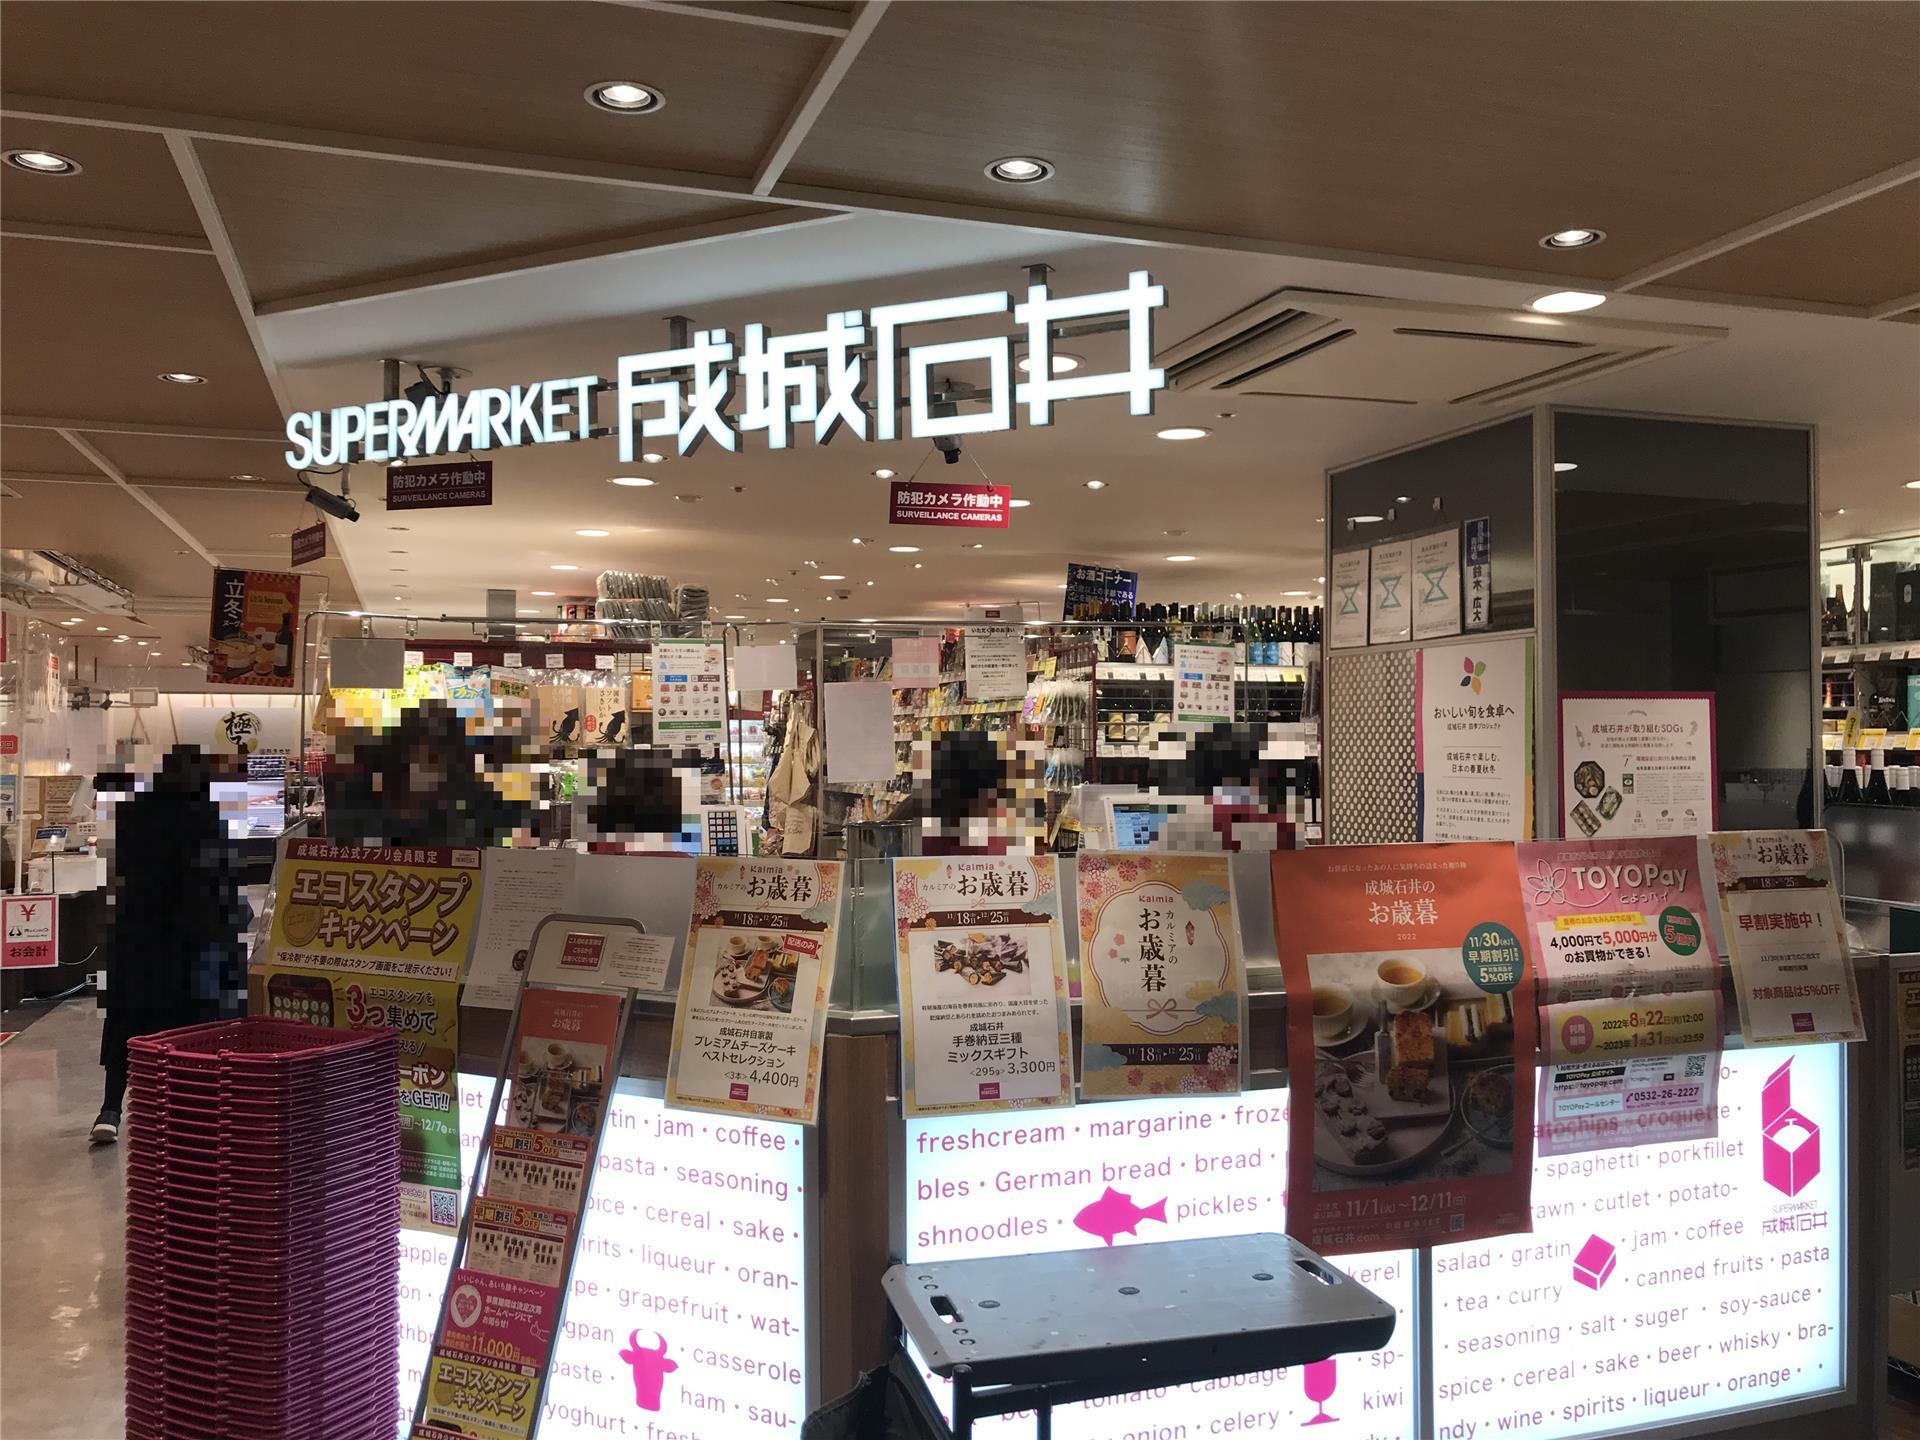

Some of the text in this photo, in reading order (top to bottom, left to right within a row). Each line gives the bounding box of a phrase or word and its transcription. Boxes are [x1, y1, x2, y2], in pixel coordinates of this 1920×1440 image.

[617, 270, 1167, 463] 成城石井
[285, 374, 598, 470] SUPERMARKET
[392, 470, 486, 489] 防犯カメラ作動中
[392, 490, 486, 503] SURVEILLANCE CAMERAS
[897, 490, 1003, 509] 防犯カメラ作動中
[896, 510, 1003, 522] SURVEILLANCE CAMERAS
[1075, 568, 1132, 584] お酒コーナー
[1472, 564, 1483, 591] 鈴木
[223, 578, 245, 619] 立冬
[1434, 703, 1515, 720] おいしい旬を食卓へ
[1591, 722, 1684, 735] 成城石井が取り組むSDGs
[1451, 764, 1497, 774] 日本の春夏秋冬
[296, 844, 439, 864] 成城石井公式アプリ会員限定
[1757, 843, 1809, 865] お歳暮
[746, 874, 813, 902] お歳暮
[922, 870, 1029, 898] カルミアの お歳暮
[1365, 878, 1436, 897] 成城石井の
[1571, 864, 1689, 892] TOYOPay
[291, 871, 470, 917] エコスタンプ
[1368, 898, 1439, 927] お歳暮
[1739, 911, 1823, 931] 早割実施中!
[319, 910, 459, 955] キャンペーン
[1165, 909, 1178, 965] カルミアの
[1396, 932, 1418, 941] 2022
[1550, 930, 1658, 949] 4,000円で5,000円分
[8, 944, 49, 958] お会計
[1138, 908, 1167, 992] お歳暮
[1468, 948, 1514, 964] 早期割引
[1564, 947, 1651, 963] のお買物ができる!
[1479, 967, 1514, 983] 5%OFF
[369, 987, 434, 1006] エコスタンプを
[1752, 984, 1841, 1000] 対象商品は5%OFF
[346, 984, 436, 1033] 3つ集めて
[719, 1027, 774, 1042] 成城石井自家製
[952, 1032, 1023, 1046] 手巻納豆三種
[969, 1021, 1004, 1033] 成城石井
[694, 1035, 797, 1057] プレミアムチーズケーキ
[702, 1050, 786, 1069] ベストセレクション
[947, 1048, 1029, 1064] ミックスギフト
[749, 1068, 800, 1088] 4,400円
[1007, 1060, 1056, 1074] 3,300円
[1565, 1070, 1590, 1080] TOYOPay
[1553, 1078, 1624, 1092] https://toyopay.com
[1633, 1087, 1700, 1102] 0532-26-2227
[655, 1113, 694, 1138] jam
[715, 1125, 787, 1151] coffee
[916, 1126, 1066, 1154] freshcream
[1090, 1109, 1214, 1139] margarine
[1546, 1137, 1745, 1180] spaghetti porkfillet
[598, 1154, 789, 1202] pasta seasoning
[917, 1147, 1262, 1201] bles German bread bread
[1177, 1193, 1259, 1223] pickles
[1594, 1189, 1651, 1213] cutlet
[1668, 1183, 1739, 1206] potato-
[1772, 1200, 1819, 1214] SUPERMARKET
[645, 1203, 785, 1244] cereal sake
[917, 1211, 1049, 1247] shnoodles
[1630, 1218, 1745, 1252] jam coffee
[1761, 1210, 1829, 1237] 成城石井
[641, 1244, 716, 1276] liqueur
[737, 1264, 799, 1290] oran-
[1436, 1240, 1572, 1275] salad gratin
[1635, 1244, 1831, 1288] canned fruits pasta
[1457, 1282, 1563, 1312] tea curry
[483, 1305, 533, 1323] ホームページにて
[618, 1287, 729, 1324] grapefruit
[750, 1314, 800, 1337] wat-
[1457, 1286, 1813, 1355] seasoning salt suger soy-sauce
[693, 1346, 801, 1385] casserole
[1370, 1348, 1405, 1370] sp-
[1437, 1321, 1835, 1403] spice cereal sake beer whisky bra-
[439, 1363, 531, 1401] エコスタンプ
[455, 1389, 526, 1422] キャンペーン
[680, 1385, 797, 1428] ham sau-
[1362, 1387, 1405, 1412] kiwi
[1438, 1366, 1791, 1440] ndy wine spirits liqueur orange
[546, 1400, 627, 1434] yoghurt
[1210, 1408, 1280, 1438] celery
